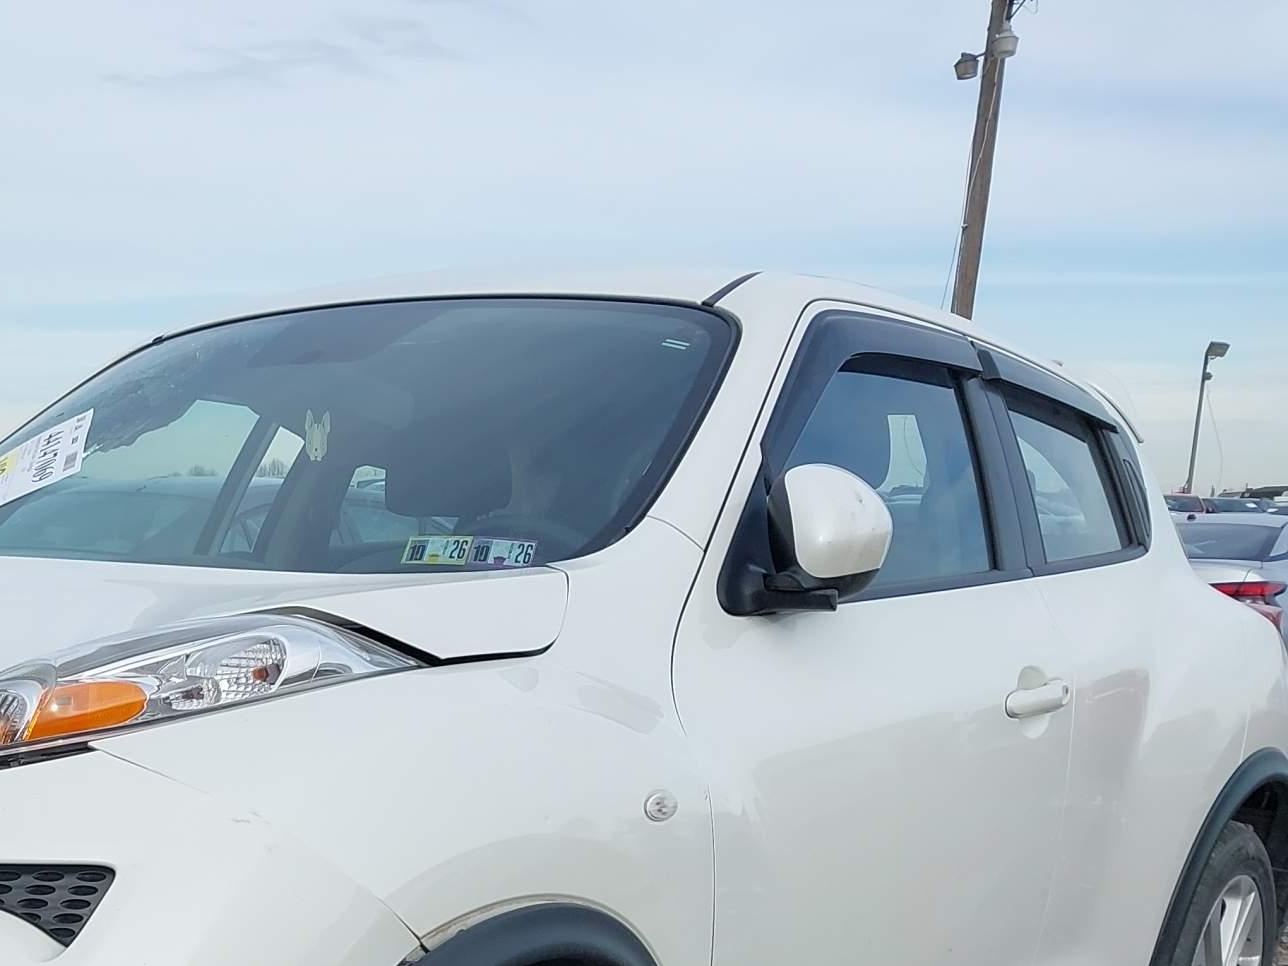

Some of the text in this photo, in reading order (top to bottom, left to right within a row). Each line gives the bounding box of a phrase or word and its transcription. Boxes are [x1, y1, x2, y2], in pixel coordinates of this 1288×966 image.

[31, 430, 64, 483] 44147069
[449, 540, 468, 559] 26
[515, 543, 533, 564] 26
